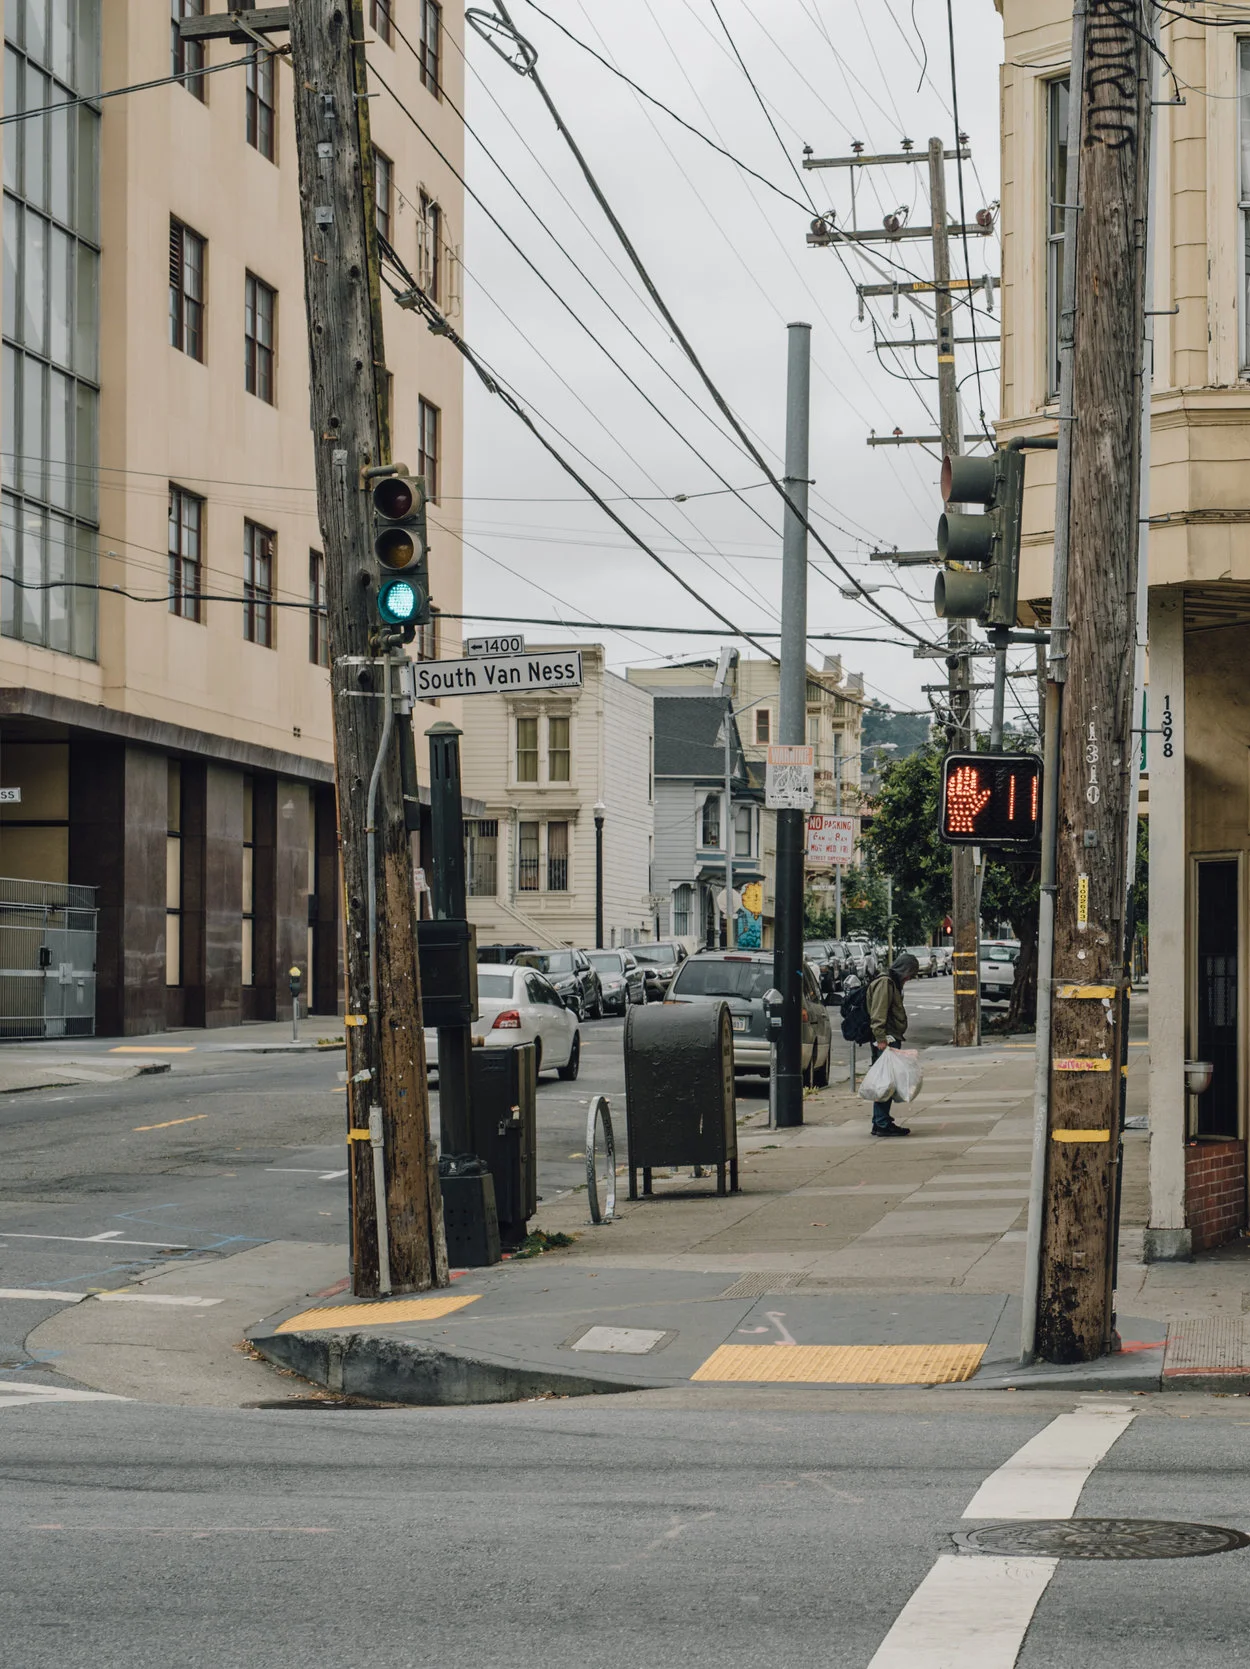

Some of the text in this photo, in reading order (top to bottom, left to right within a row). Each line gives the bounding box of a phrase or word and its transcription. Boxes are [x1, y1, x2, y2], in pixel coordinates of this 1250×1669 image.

[484, 638, 520, 653] 1400
[418, 661, 576, 690] South Van Ness
[1162, 695, 1174, 758] 1398
[1085, 721, 1100, 805] 1310
[1008, 775, 1038, 820] 11
[809, 816, 851, 830] NO PARKING
